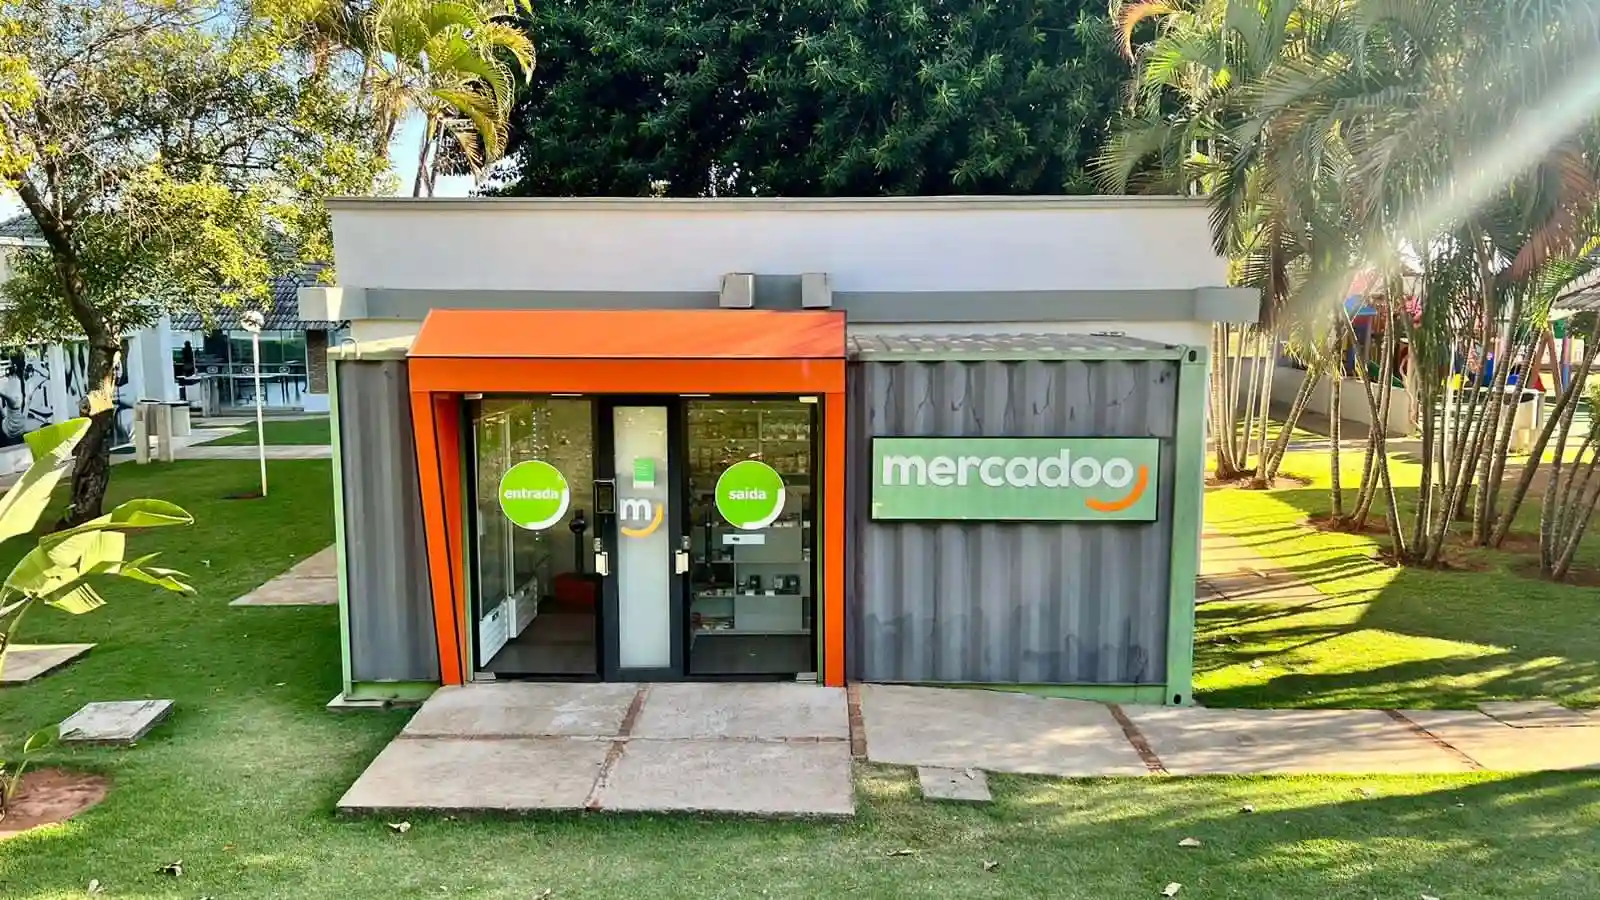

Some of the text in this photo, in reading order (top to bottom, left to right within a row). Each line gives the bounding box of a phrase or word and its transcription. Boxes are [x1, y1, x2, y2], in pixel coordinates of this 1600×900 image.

[882, 448, 1133, 488] mercadoo
[504, 487, 559, 500] entrada
[620, 499, 651, 520] m
